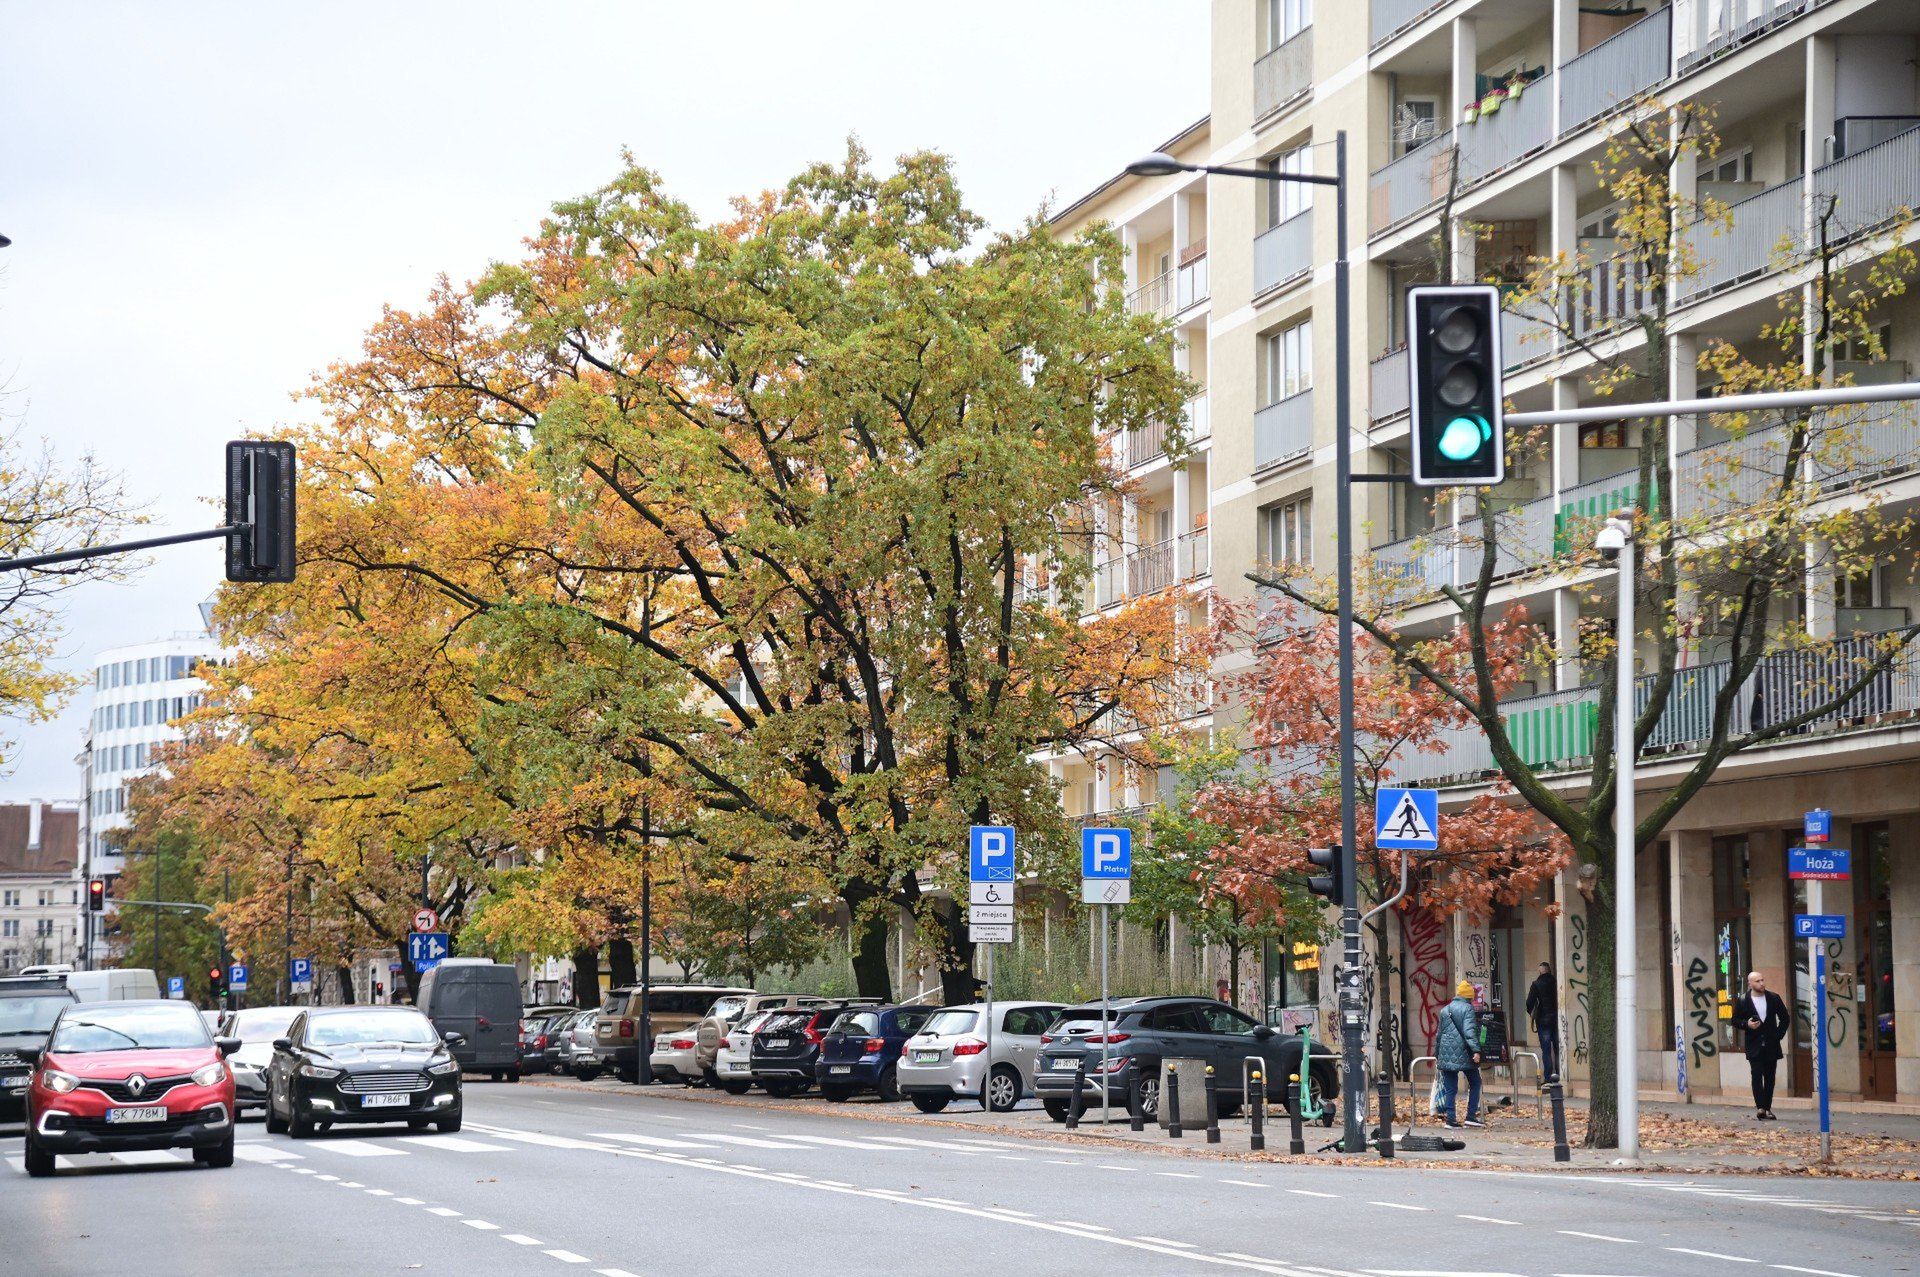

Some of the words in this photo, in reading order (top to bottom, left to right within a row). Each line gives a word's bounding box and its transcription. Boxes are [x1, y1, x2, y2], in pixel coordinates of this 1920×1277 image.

[981, 832, 1006, 866] P
[1094, 833, 1121, 872] P
[1806, 856, 1834, 869] Hoża
[1104, 865, 1128, 874] Płatny
[981, 910, 1007, 919] miejsca
[1802, 920, 1811, 931] P
[294, 960, 307, 976] P
[232, 968, 244, 982] P
[172, 979, 181, 990] P
[382, 1094, 408, 1104] 786FY
[113, 1109, 128, 1120] SK
[132, 1108, 165, 1119] 778MJ
